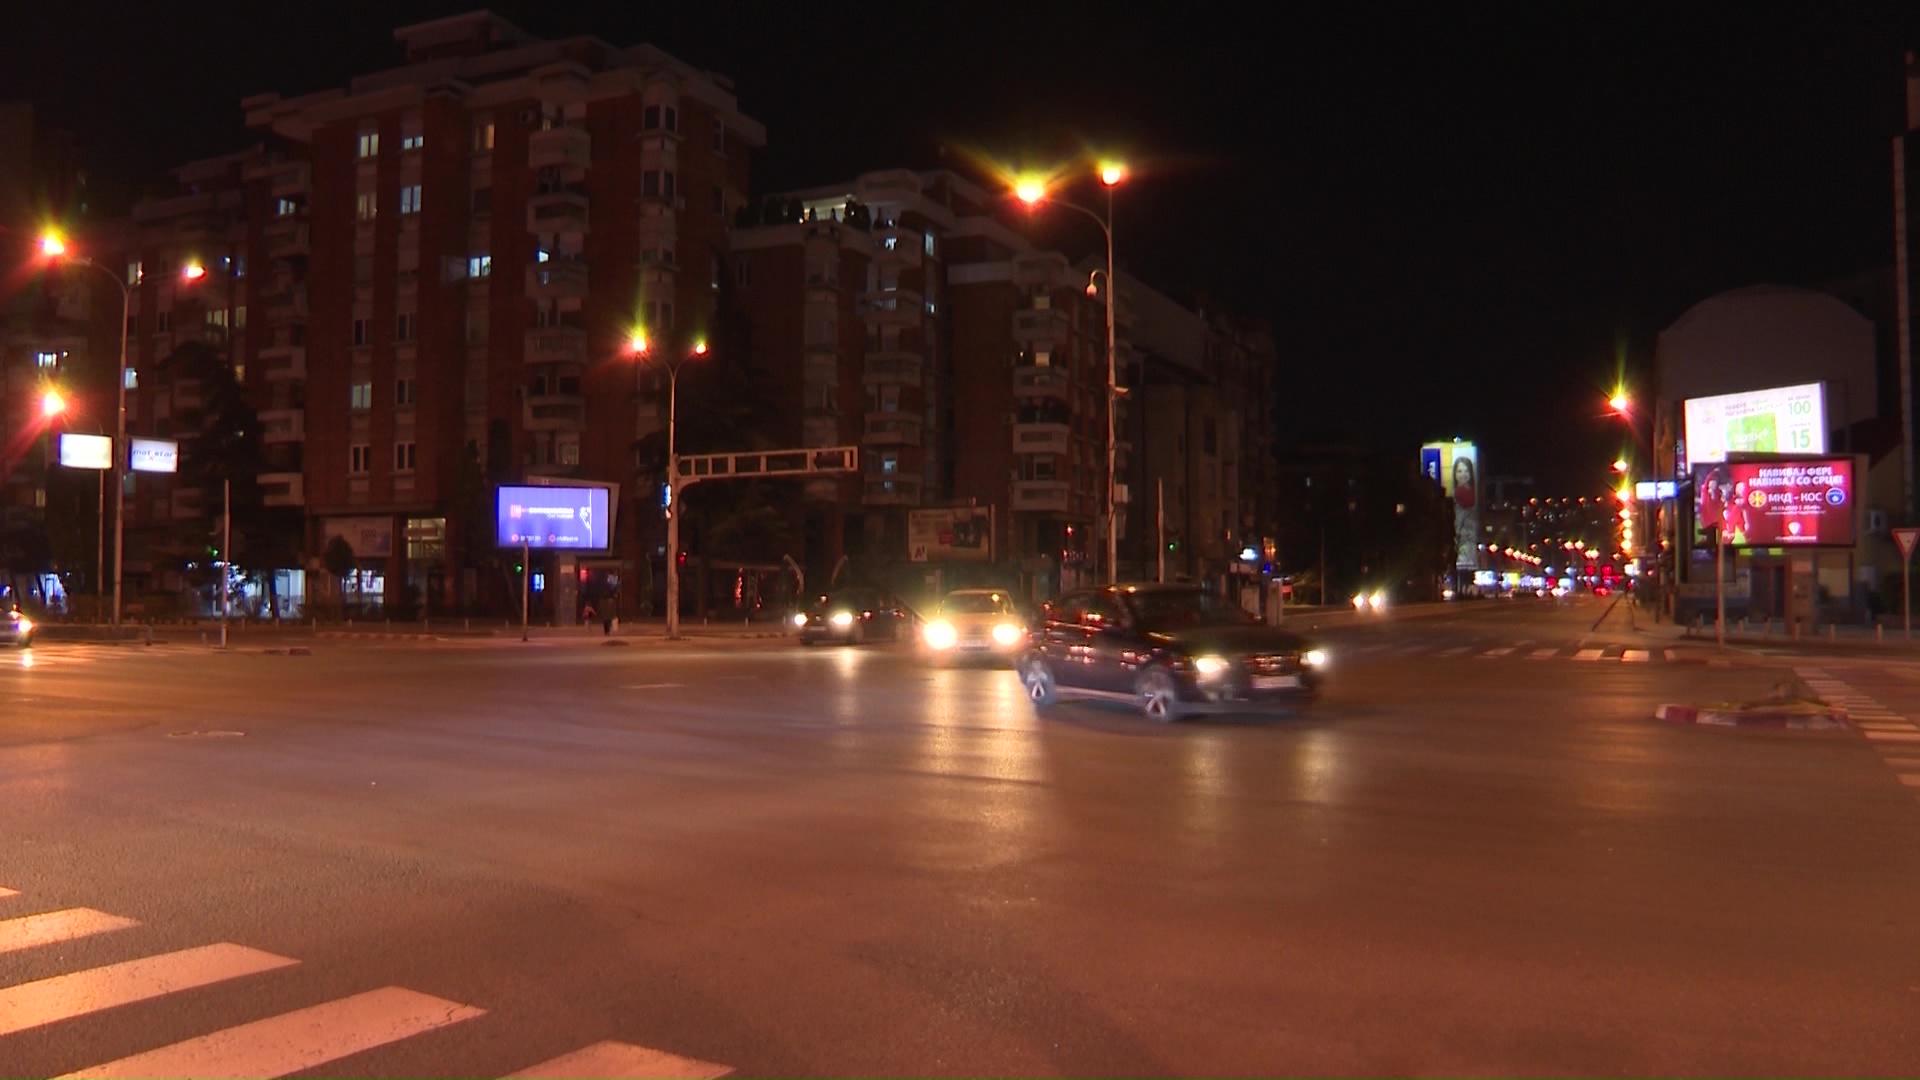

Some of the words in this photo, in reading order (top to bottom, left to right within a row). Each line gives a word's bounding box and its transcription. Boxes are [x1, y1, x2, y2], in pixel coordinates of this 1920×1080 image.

[1788, 401, 1812, 415] 100
[1791, 429, 1811, 448] 15
[1759, 468, 1805, 477] НАВИВАЈ
[1749, 478, 1795, 486] НАВИВАЈ
[1796, 476, 1811, 485] СО
[1768, 492, 1793, 503] МКД
[1800, 492, 1823, 502] КОС
